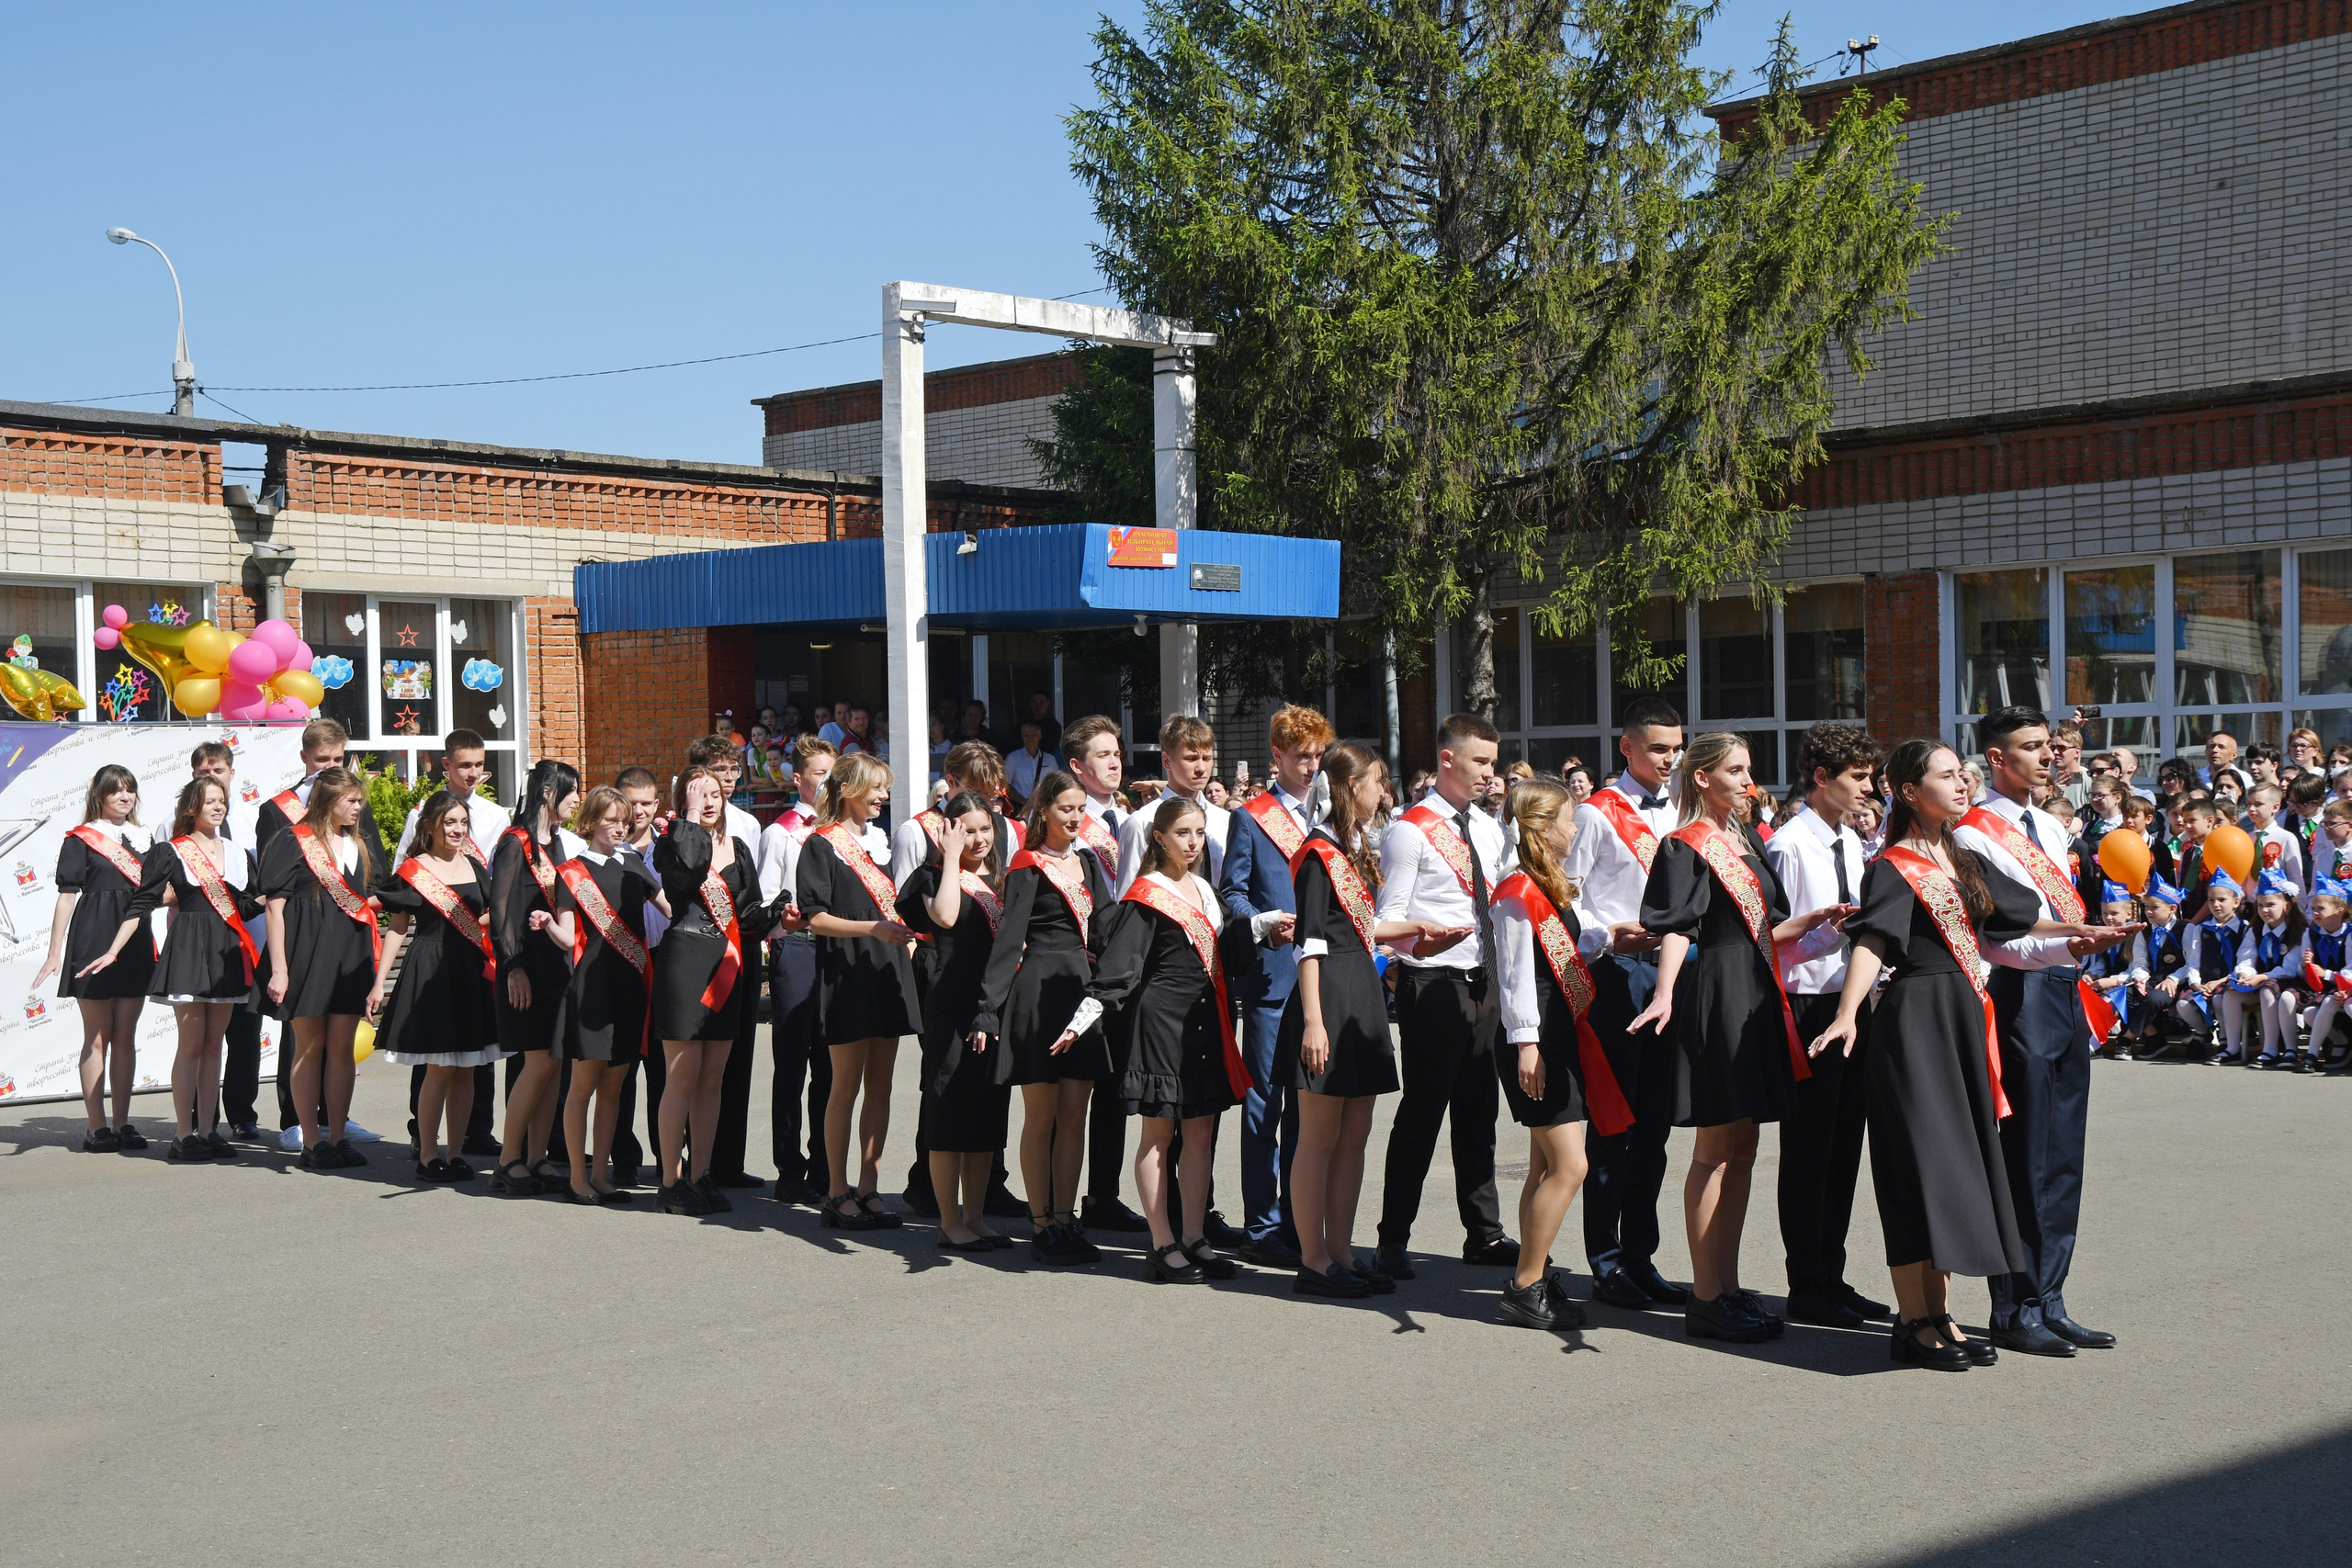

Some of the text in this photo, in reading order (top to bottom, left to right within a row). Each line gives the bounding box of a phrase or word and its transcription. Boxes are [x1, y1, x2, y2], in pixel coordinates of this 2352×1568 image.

[147, 752, 174, 767] Страна
[140, 762, 181, 783] творчества
[280, 766, 306, 781] Страна
[30, 794, 59, 808] Страна
[34, 1056, 64, 1073] Страна
[26, 1067, 71, 1089] творчества
